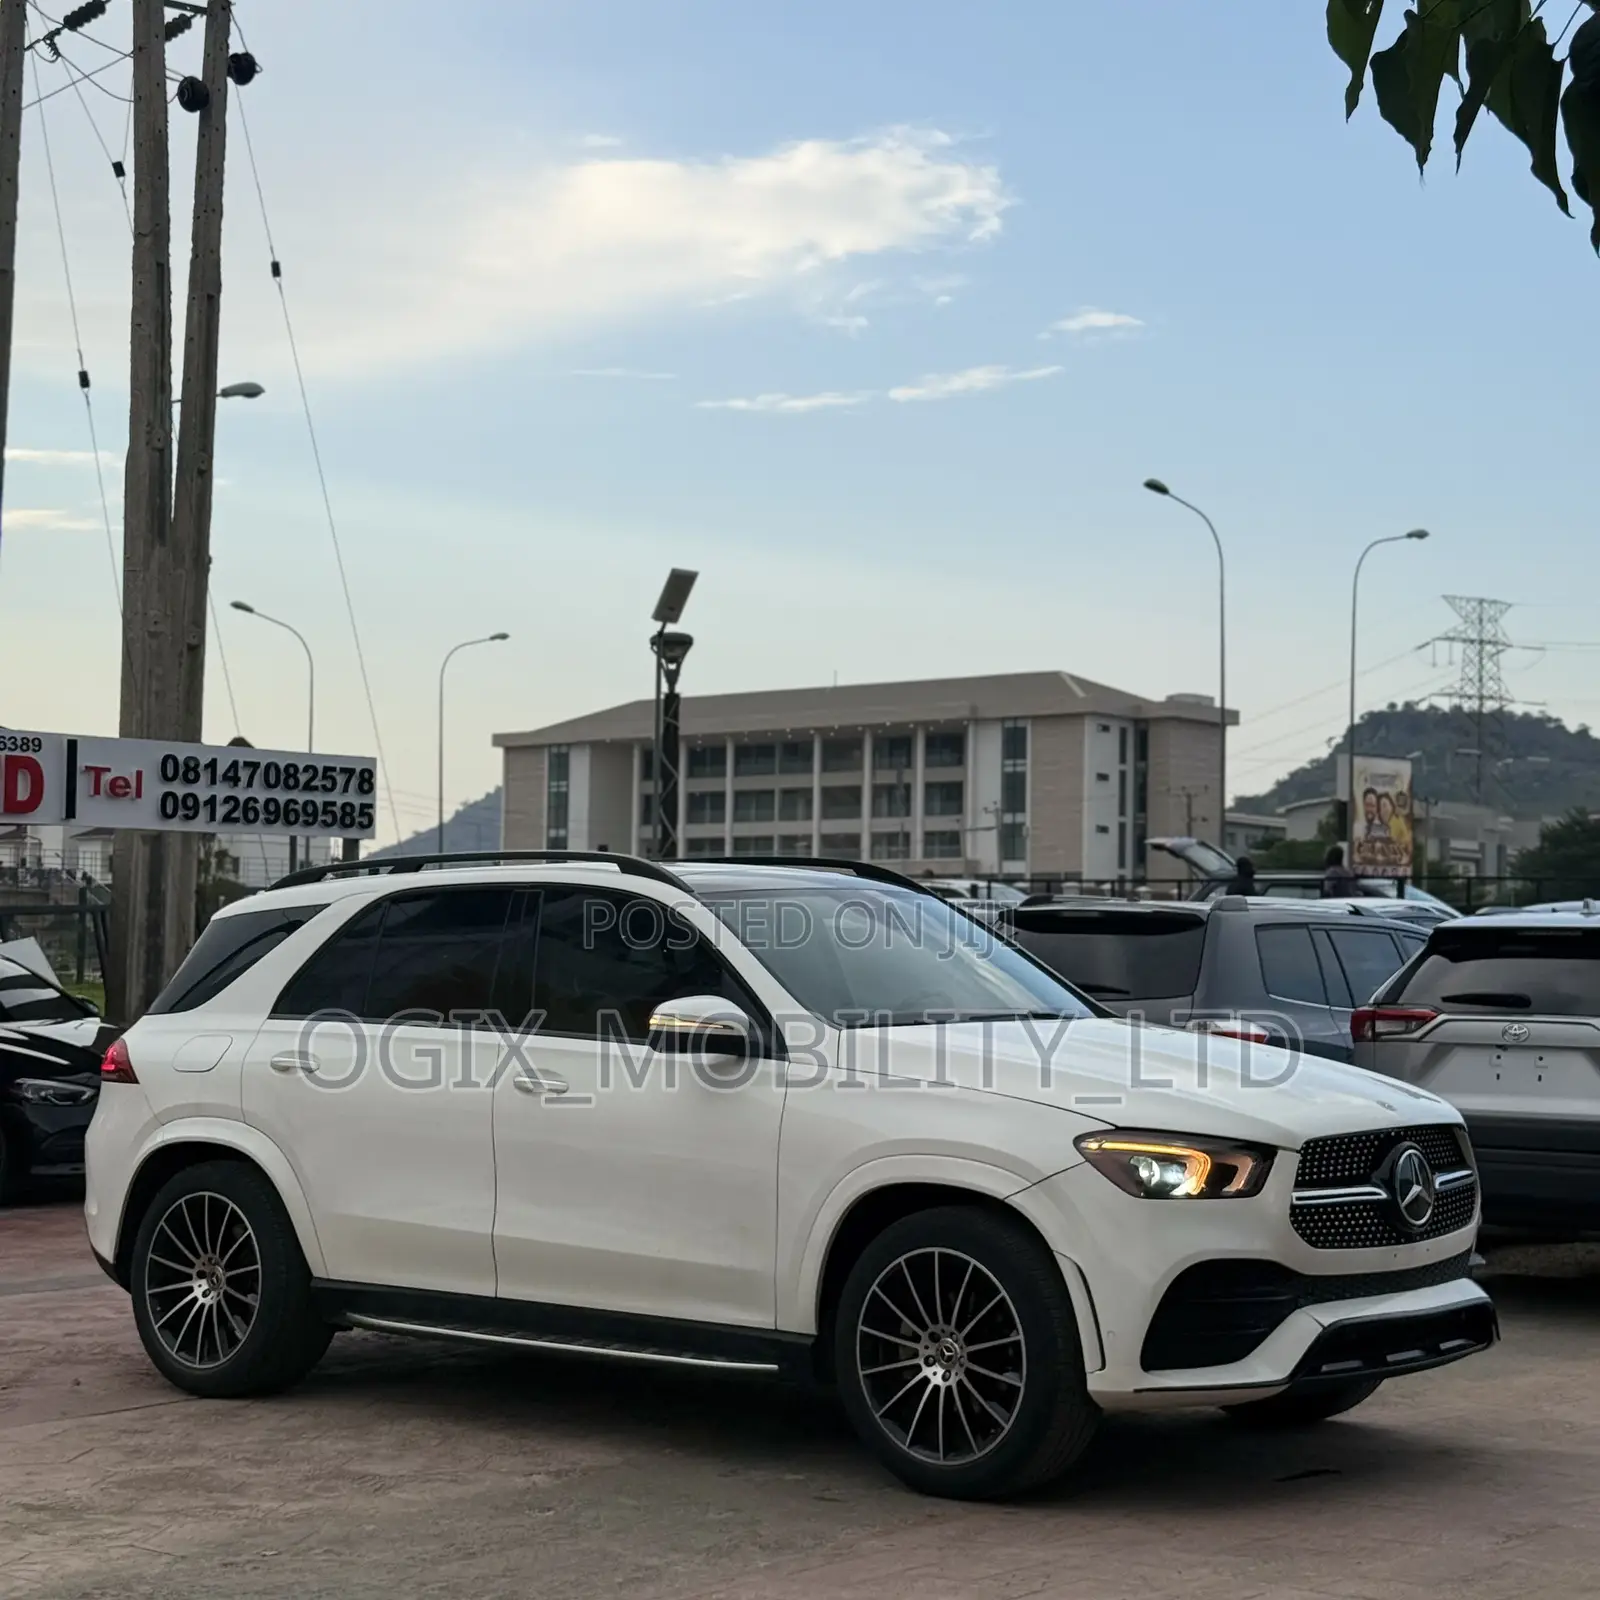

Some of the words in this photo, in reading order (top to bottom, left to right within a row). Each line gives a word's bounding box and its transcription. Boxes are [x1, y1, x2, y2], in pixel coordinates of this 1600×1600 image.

[3, 754, 45, 815] D
[84, 765, 143, 799] Tel
[160, 753, 374, 795] 08147082578
[160, 791, 374, 830] 09126969585
